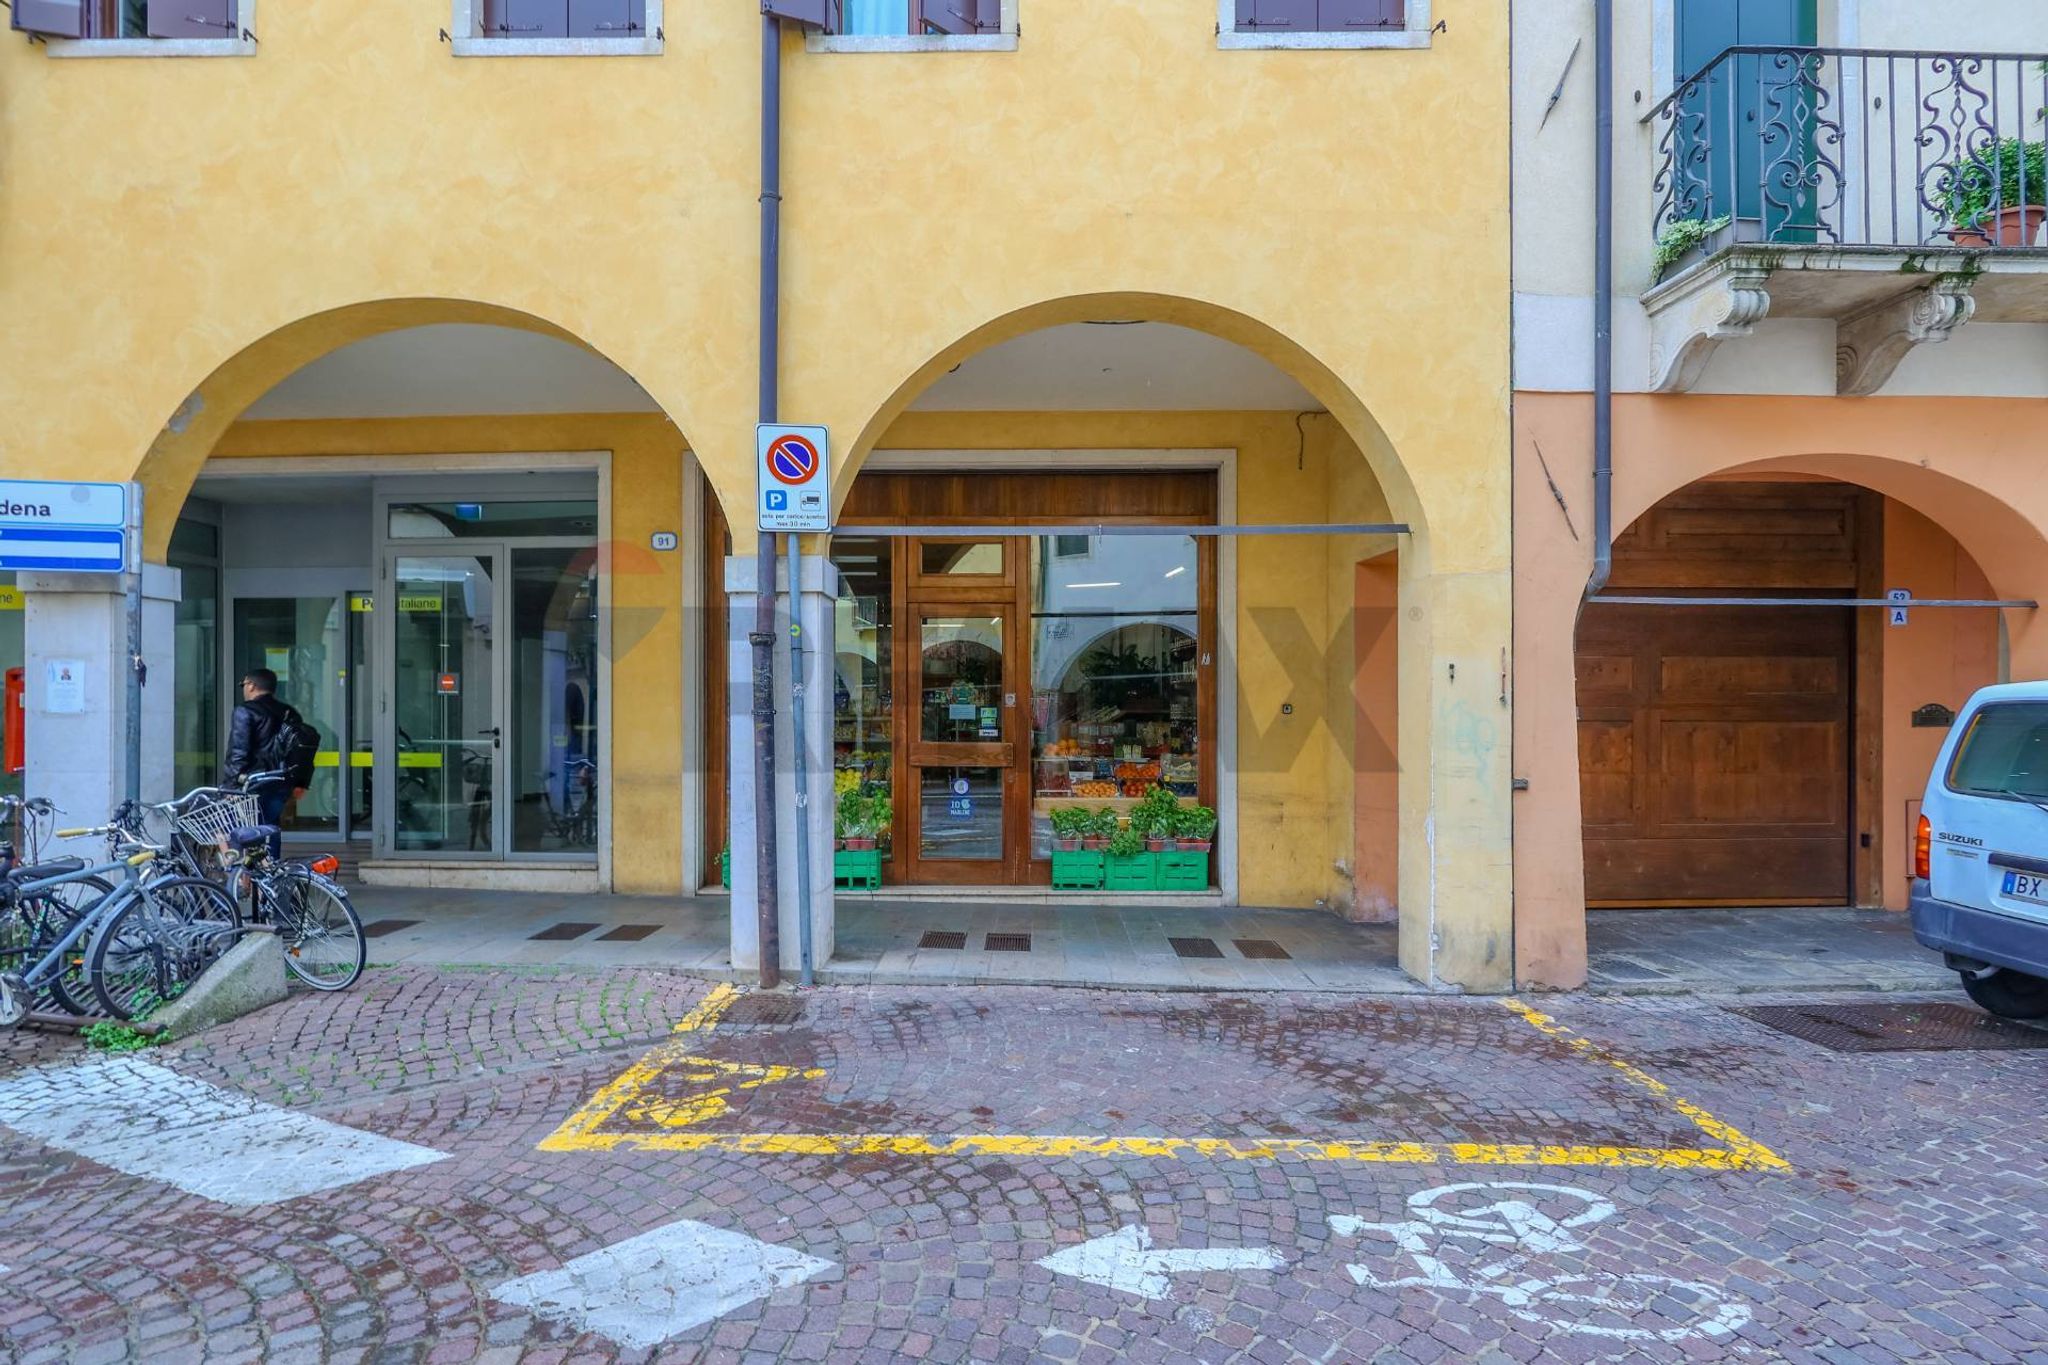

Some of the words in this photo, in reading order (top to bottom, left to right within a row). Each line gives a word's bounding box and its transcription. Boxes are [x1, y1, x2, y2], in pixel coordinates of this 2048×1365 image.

[770, 493, 782, 507] P
[0, 499, 51, 516] dena
[657, 537, 669, 546] 91
[1894, 611, 1904, 622] A
[1938, 832, 1983, 846] SUZUKI
[2016, 875, 2042, 897] BX
